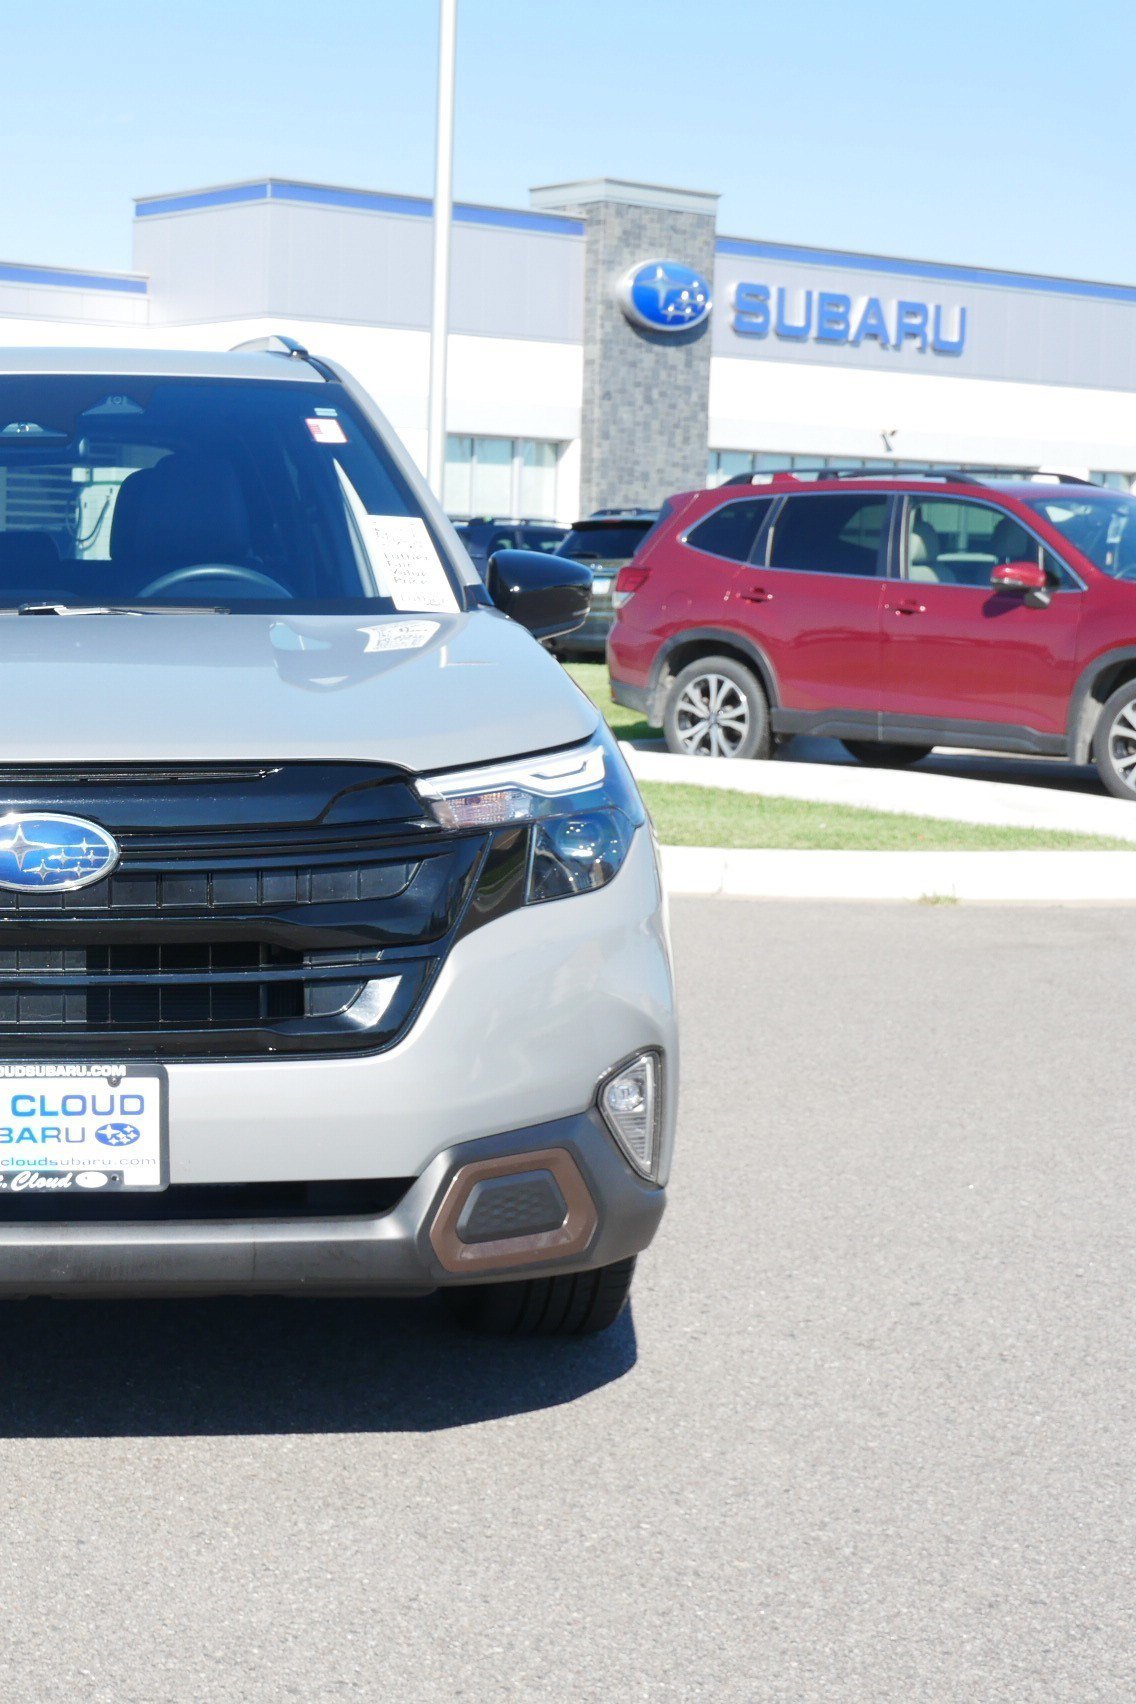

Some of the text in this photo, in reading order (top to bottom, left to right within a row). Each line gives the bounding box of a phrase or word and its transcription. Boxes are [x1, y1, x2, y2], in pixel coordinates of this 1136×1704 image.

[732, 281, 968, 355] SUBARU
[10, 1094, 146, 1117] CLOUD
[10, 1170, 73, 1192] Cloud
